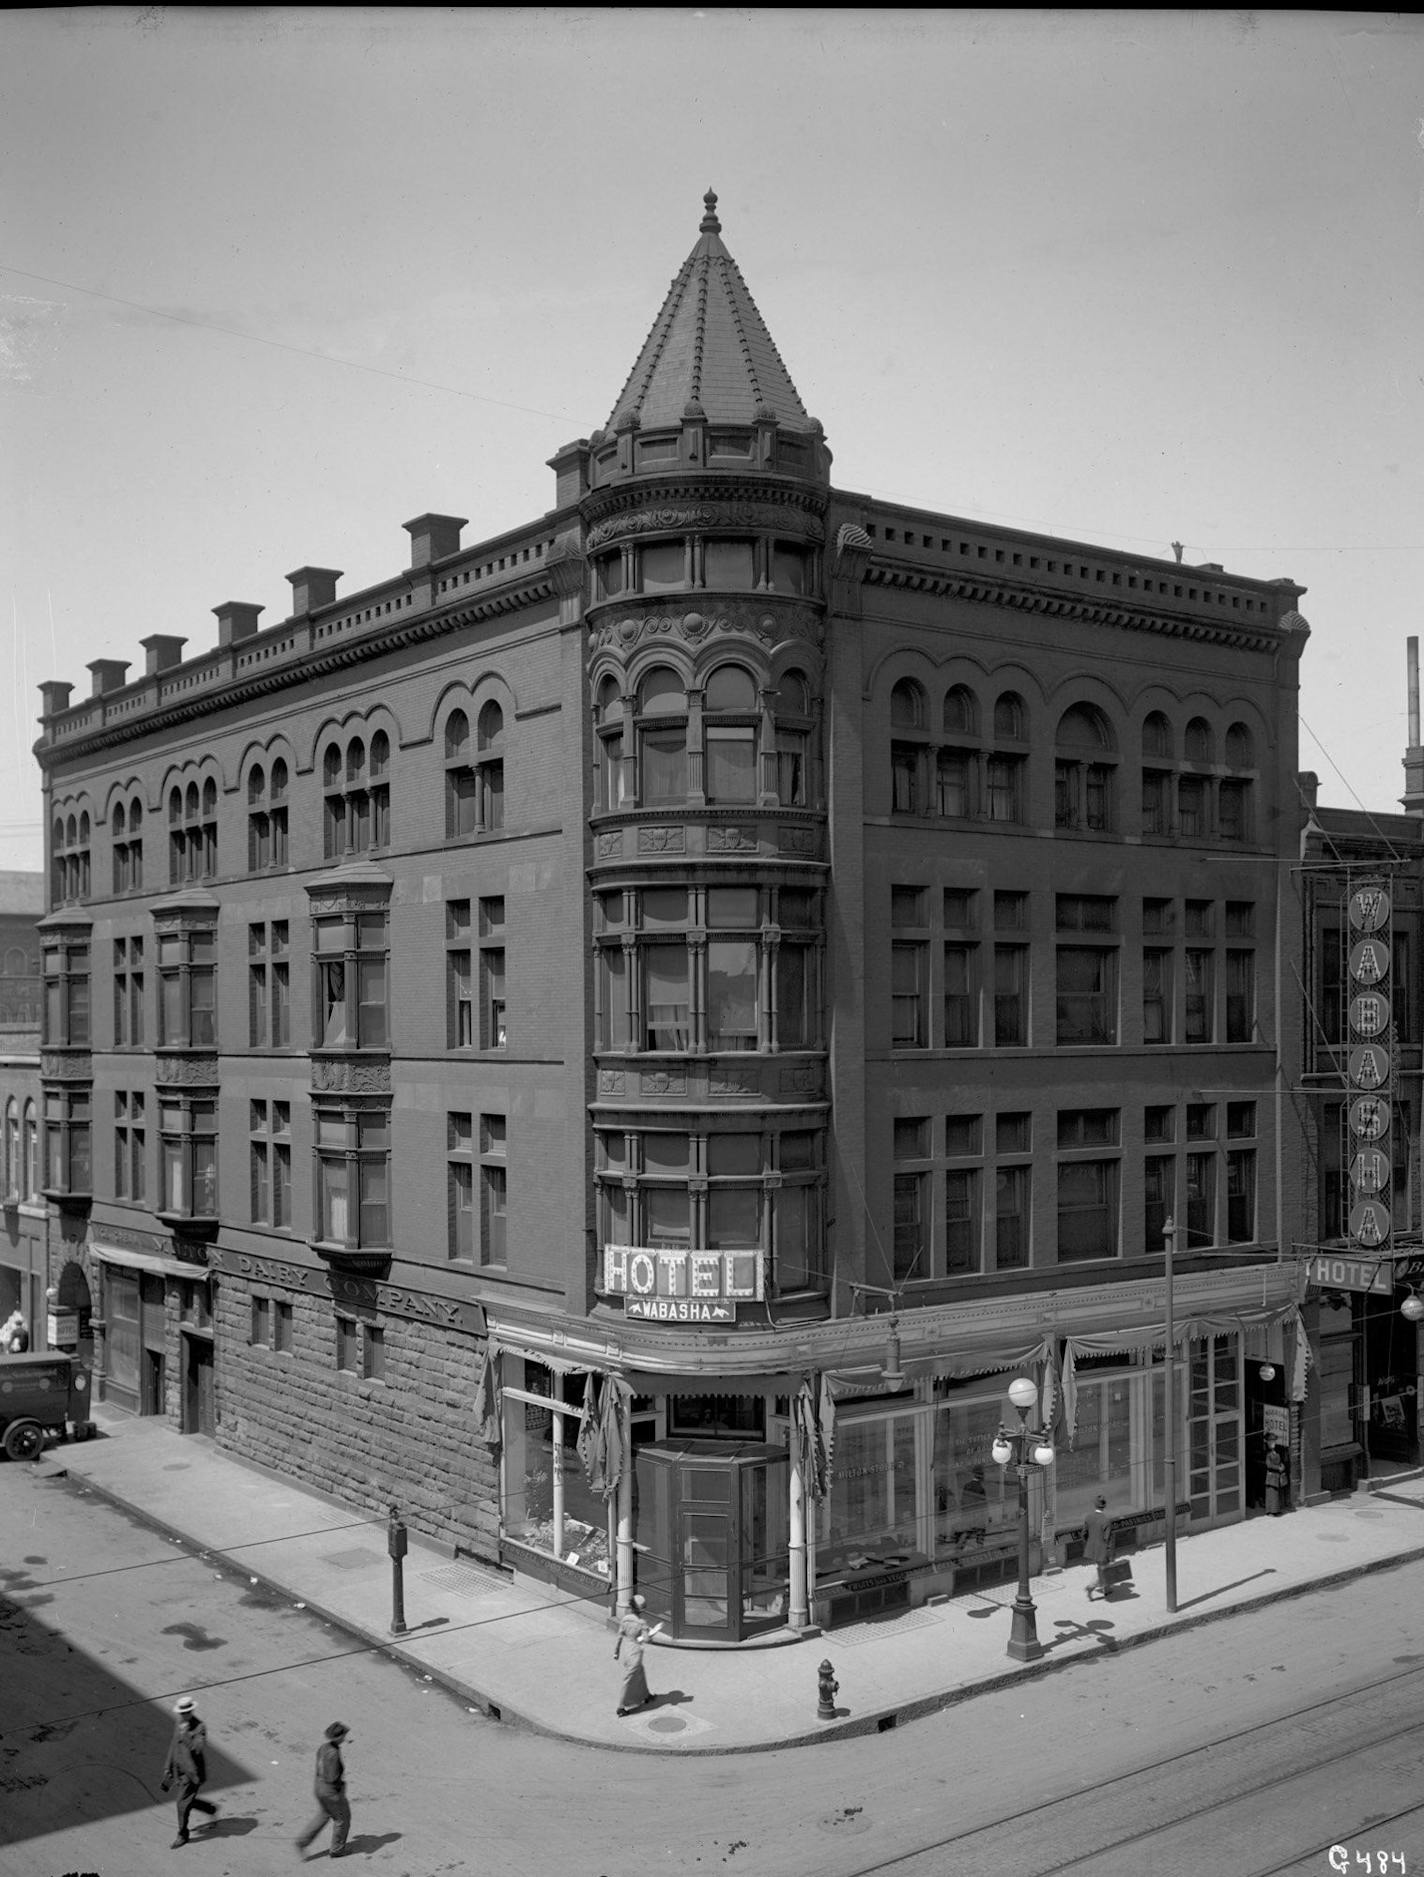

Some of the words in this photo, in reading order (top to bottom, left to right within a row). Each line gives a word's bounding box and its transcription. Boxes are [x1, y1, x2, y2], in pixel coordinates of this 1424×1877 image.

[1355, 891, 1382, 1242] WABASHA
[152, 1236, 223, 1266] MILTON
[237, 1255, 308, 1287] DAIRY
[606, 1249, 756, 1297] HOTEL
[1316, 1259, 1387, 1289] HOTEL
[643, 1301, 711, 1320] WABASHA
